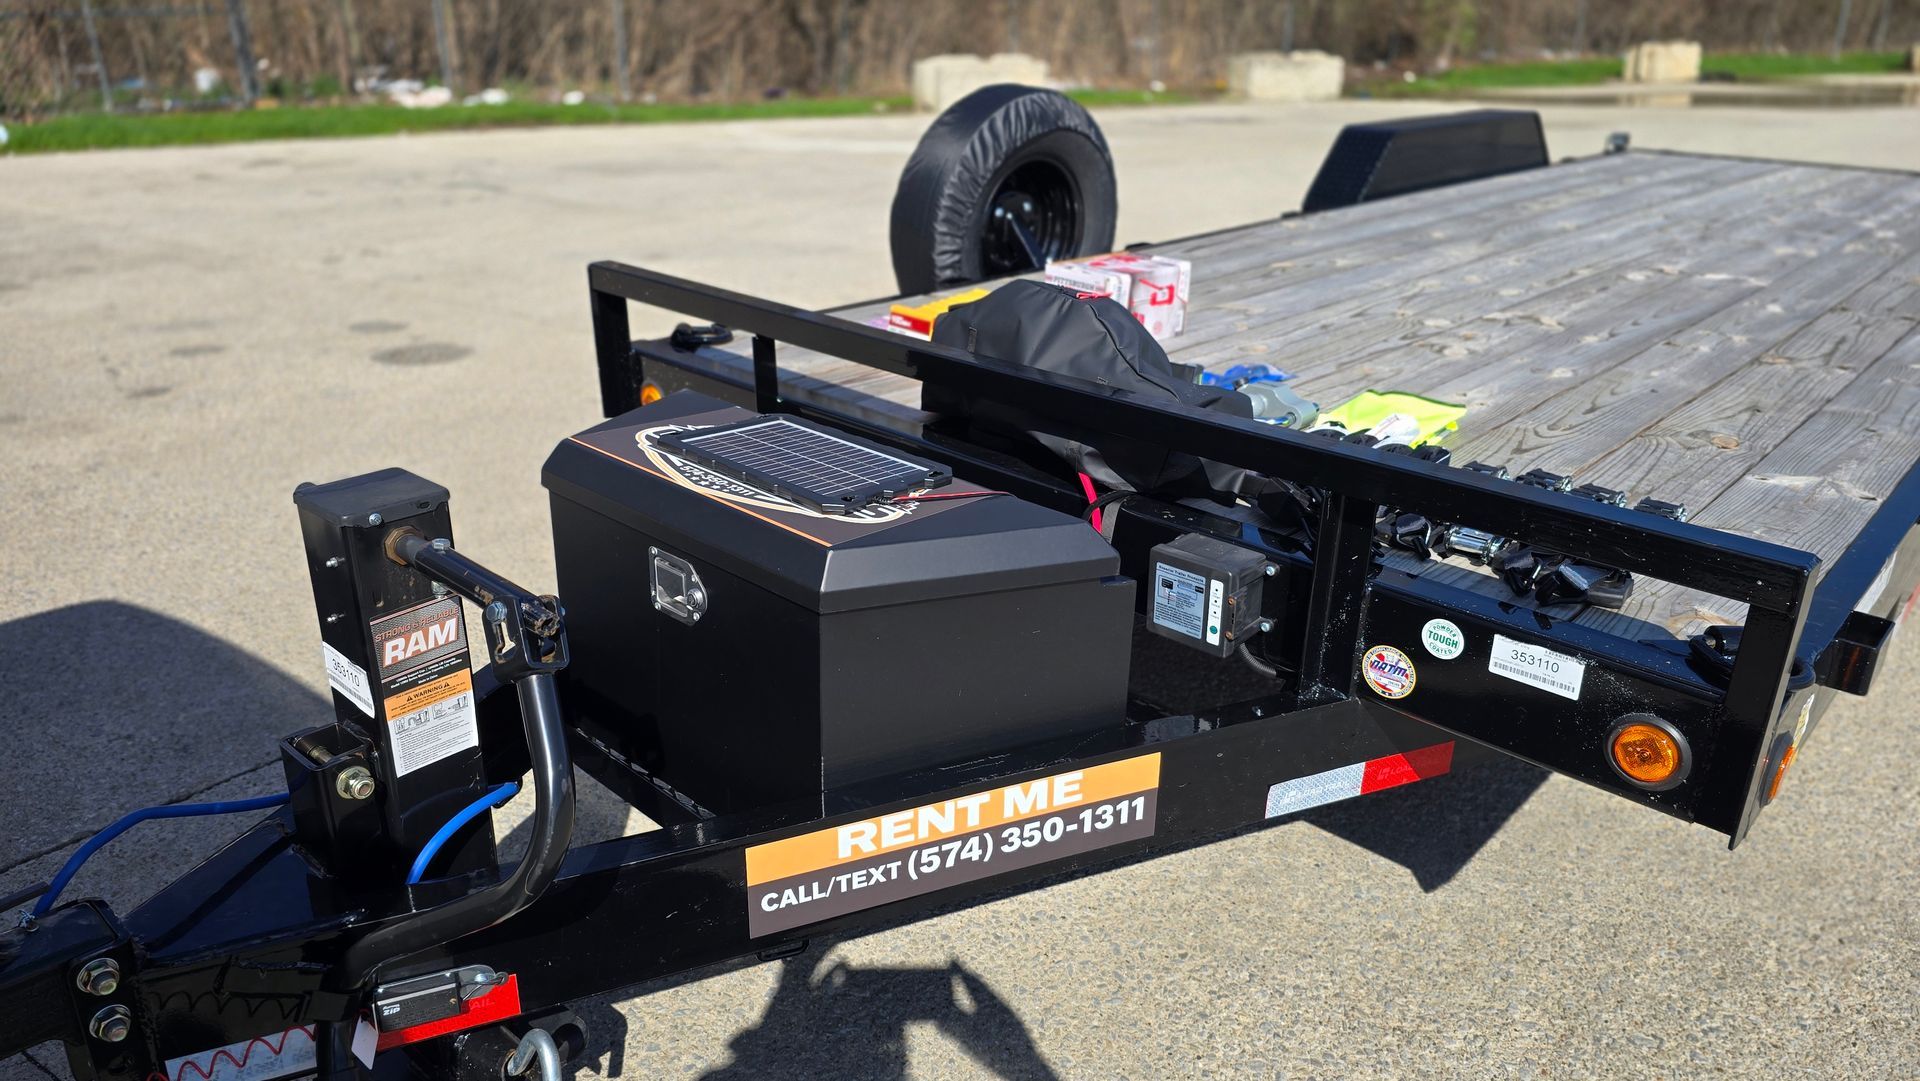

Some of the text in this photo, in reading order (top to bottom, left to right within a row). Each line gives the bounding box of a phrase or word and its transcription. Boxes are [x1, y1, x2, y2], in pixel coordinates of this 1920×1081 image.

[680, 465, 755, 496] 574-350-1311
[375, 623, 411, 642] STRONG
[420, 606, 460, 625] RELIABLE
[1432, 624, 1457, 638] POWDER
[384, 617, 458, 668] RAM
[1428, 629, 1459, 649] TOUGH
[1429, 641, 1453, 655] COATED
[332, 658, 360, 687] 353110
[1510, 649, 1560, 673] 353110
[413, 684, 444, 699] WARNING
[836, 771, 1084, 859] RENT ME
[760, 795, 1146, 912] CALL/TEXT (574) 350-1311
